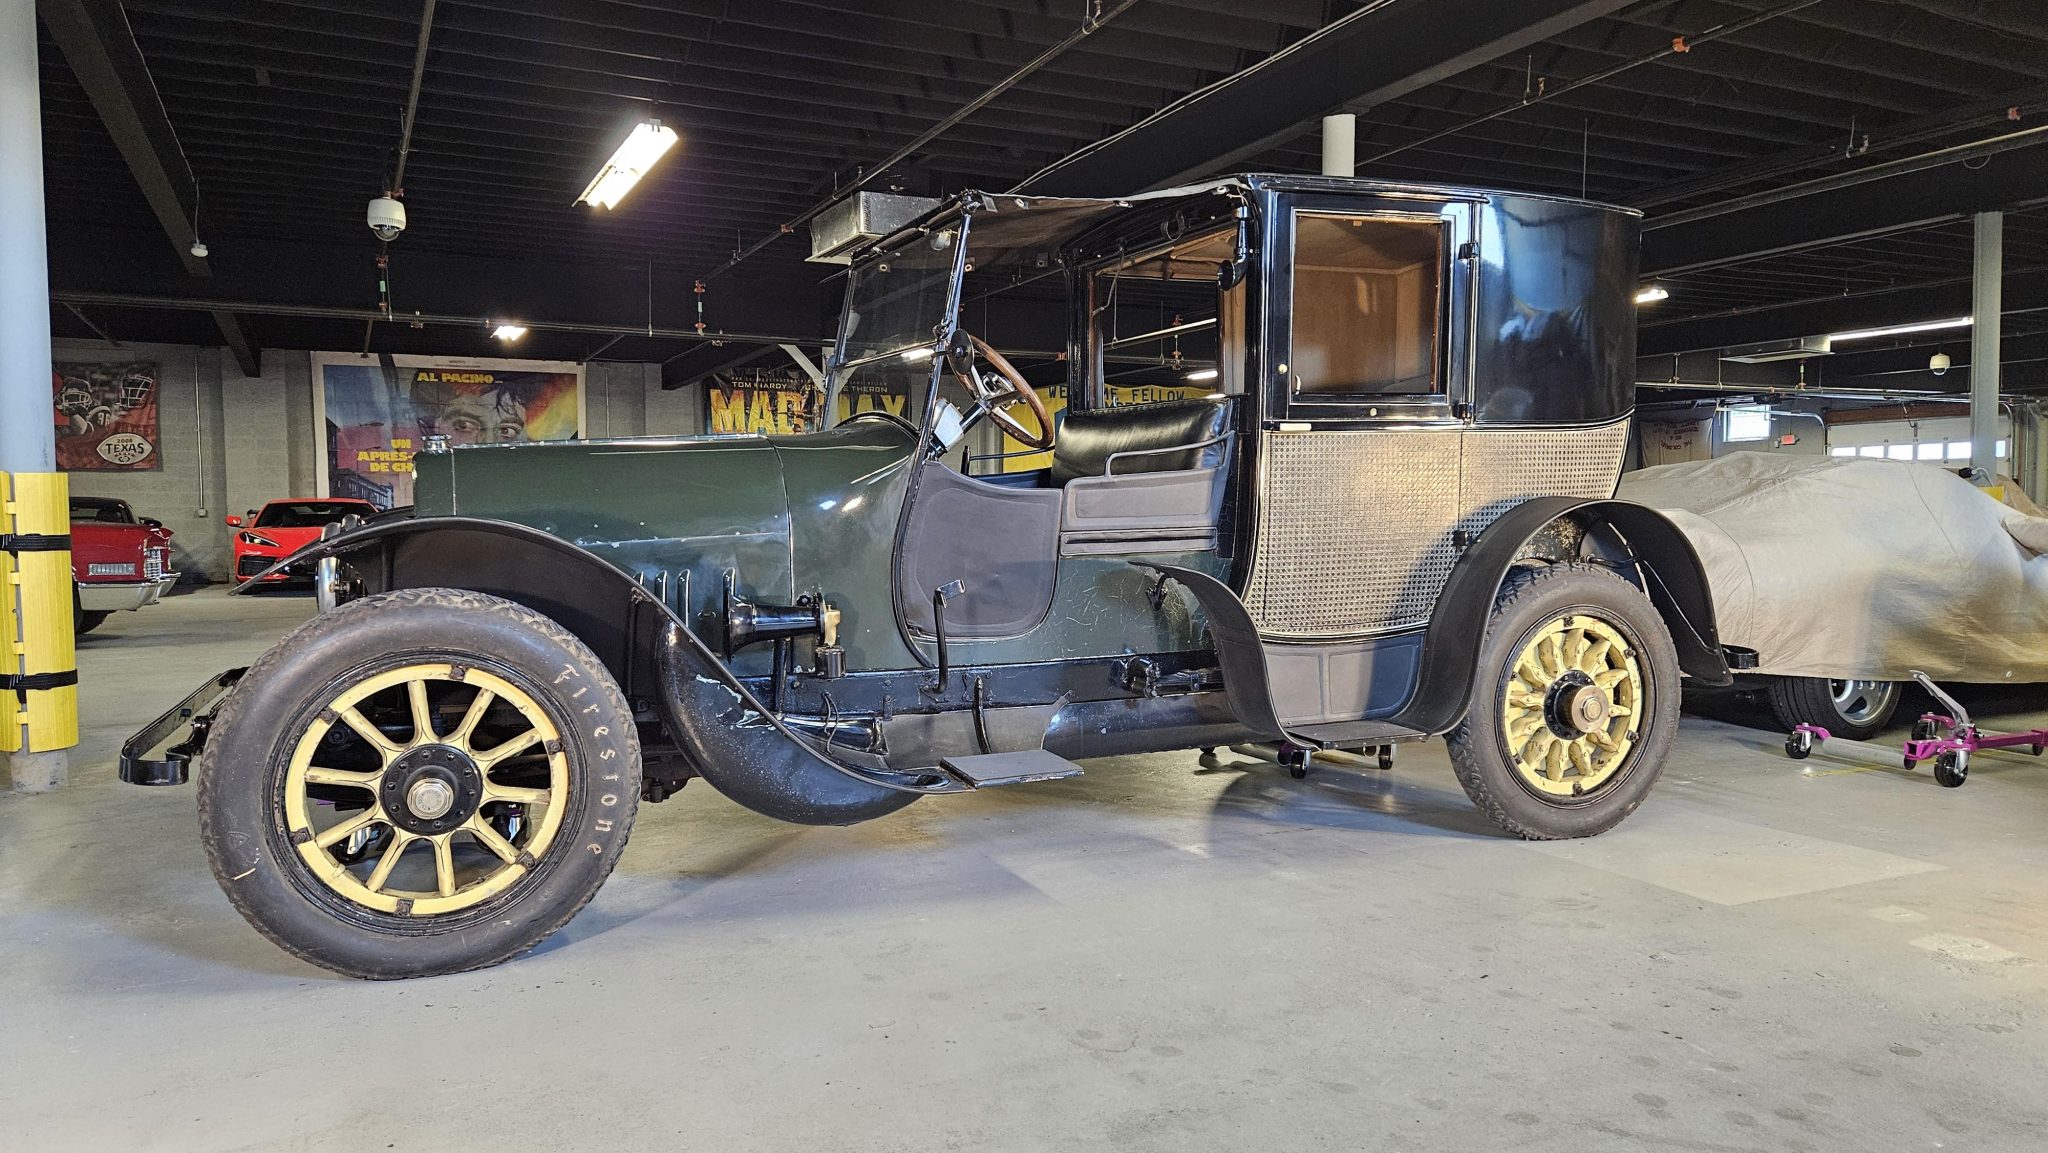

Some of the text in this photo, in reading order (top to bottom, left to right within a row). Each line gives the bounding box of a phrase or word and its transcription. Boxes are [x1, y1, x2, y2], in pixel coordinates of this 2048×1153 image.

[417, 372, 494, 384] AL PACINO
[851, 385, 888, 393] THERON
[1132, 388, 1185, 402] FELLOW
[106, 443, 144, 454] TEXAS
[391, 439, 412, 449] UN
[357, 451, 416, 461] APRES-
[370, 463, 389, 472] DE
